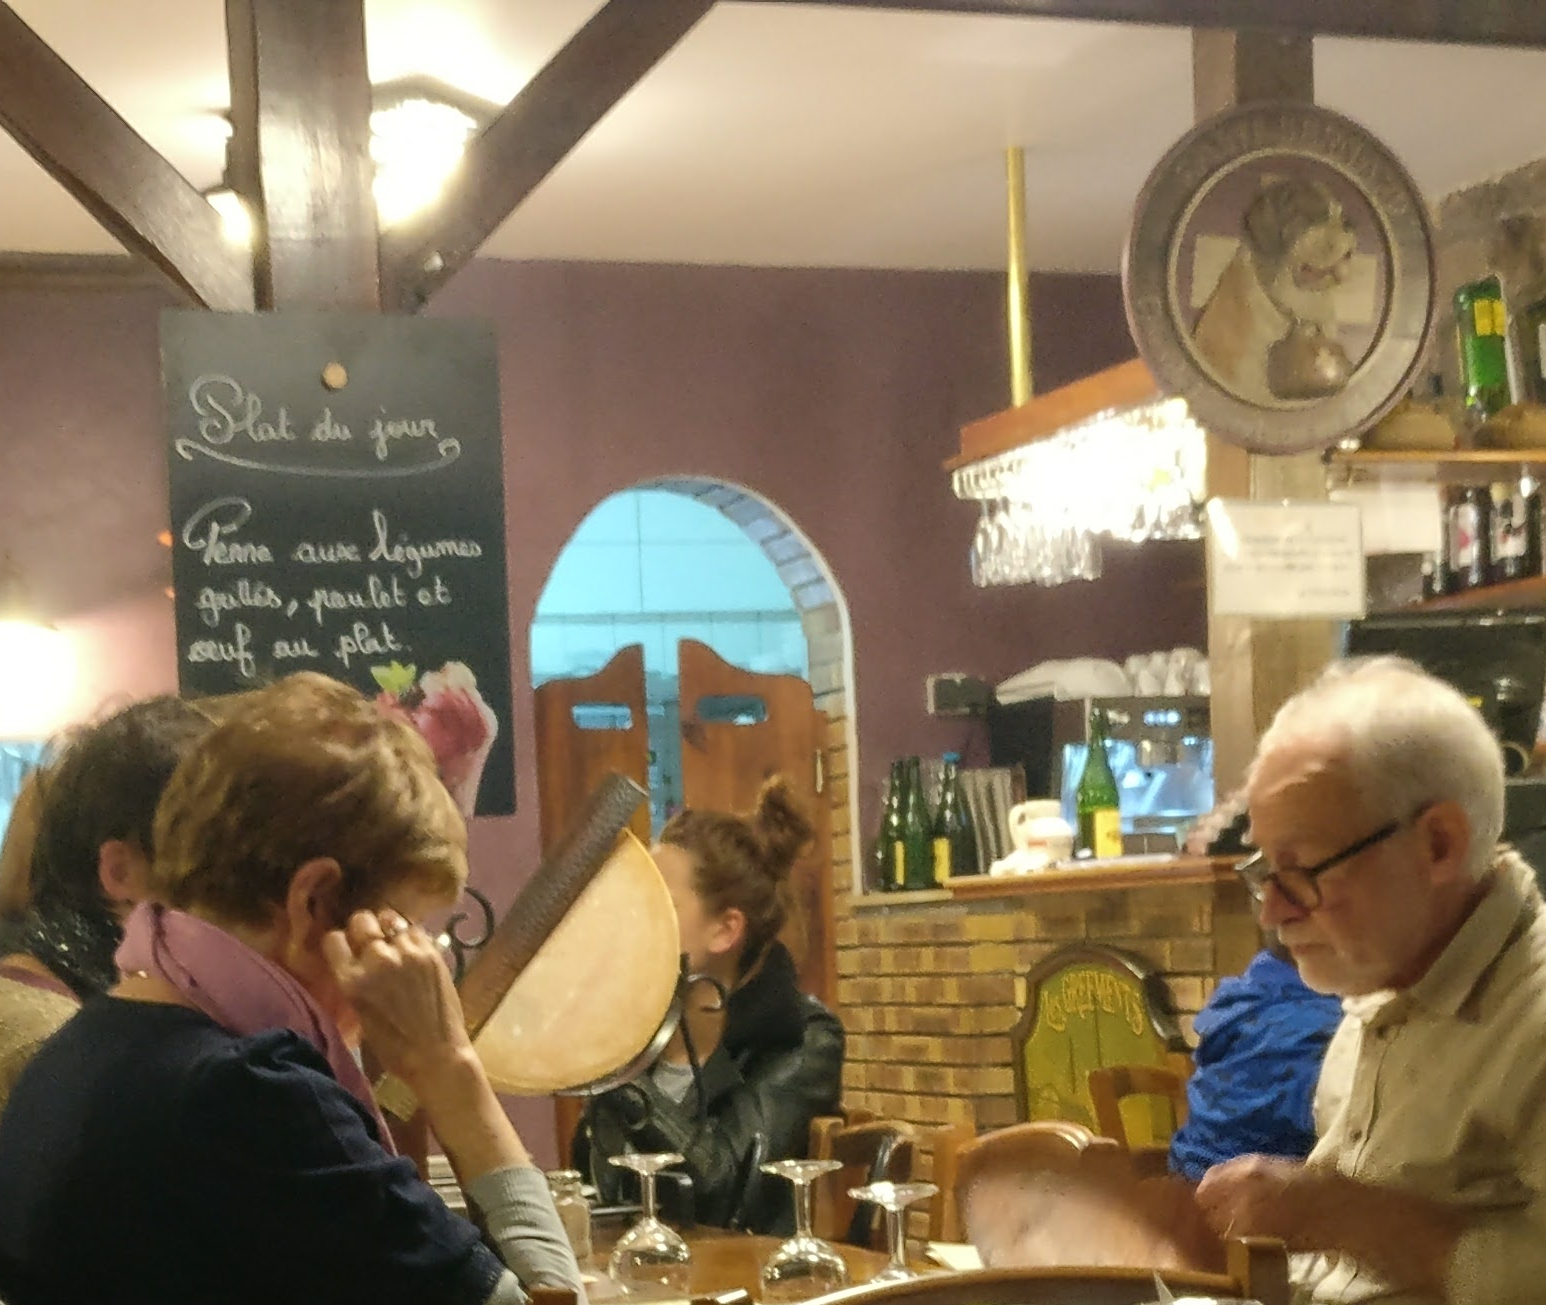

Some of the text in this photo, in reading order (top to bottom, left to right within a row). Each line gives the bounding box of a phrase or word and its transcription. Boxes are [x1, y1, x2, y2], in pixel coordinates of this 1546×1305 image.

[189, 375, 438, 461] Plat du jour
[291, 541, 361, 563] aux
[308, 575, 406, 625] poulet
[416, 575, 452, 607] et
[272, 638, 319, 659] au
